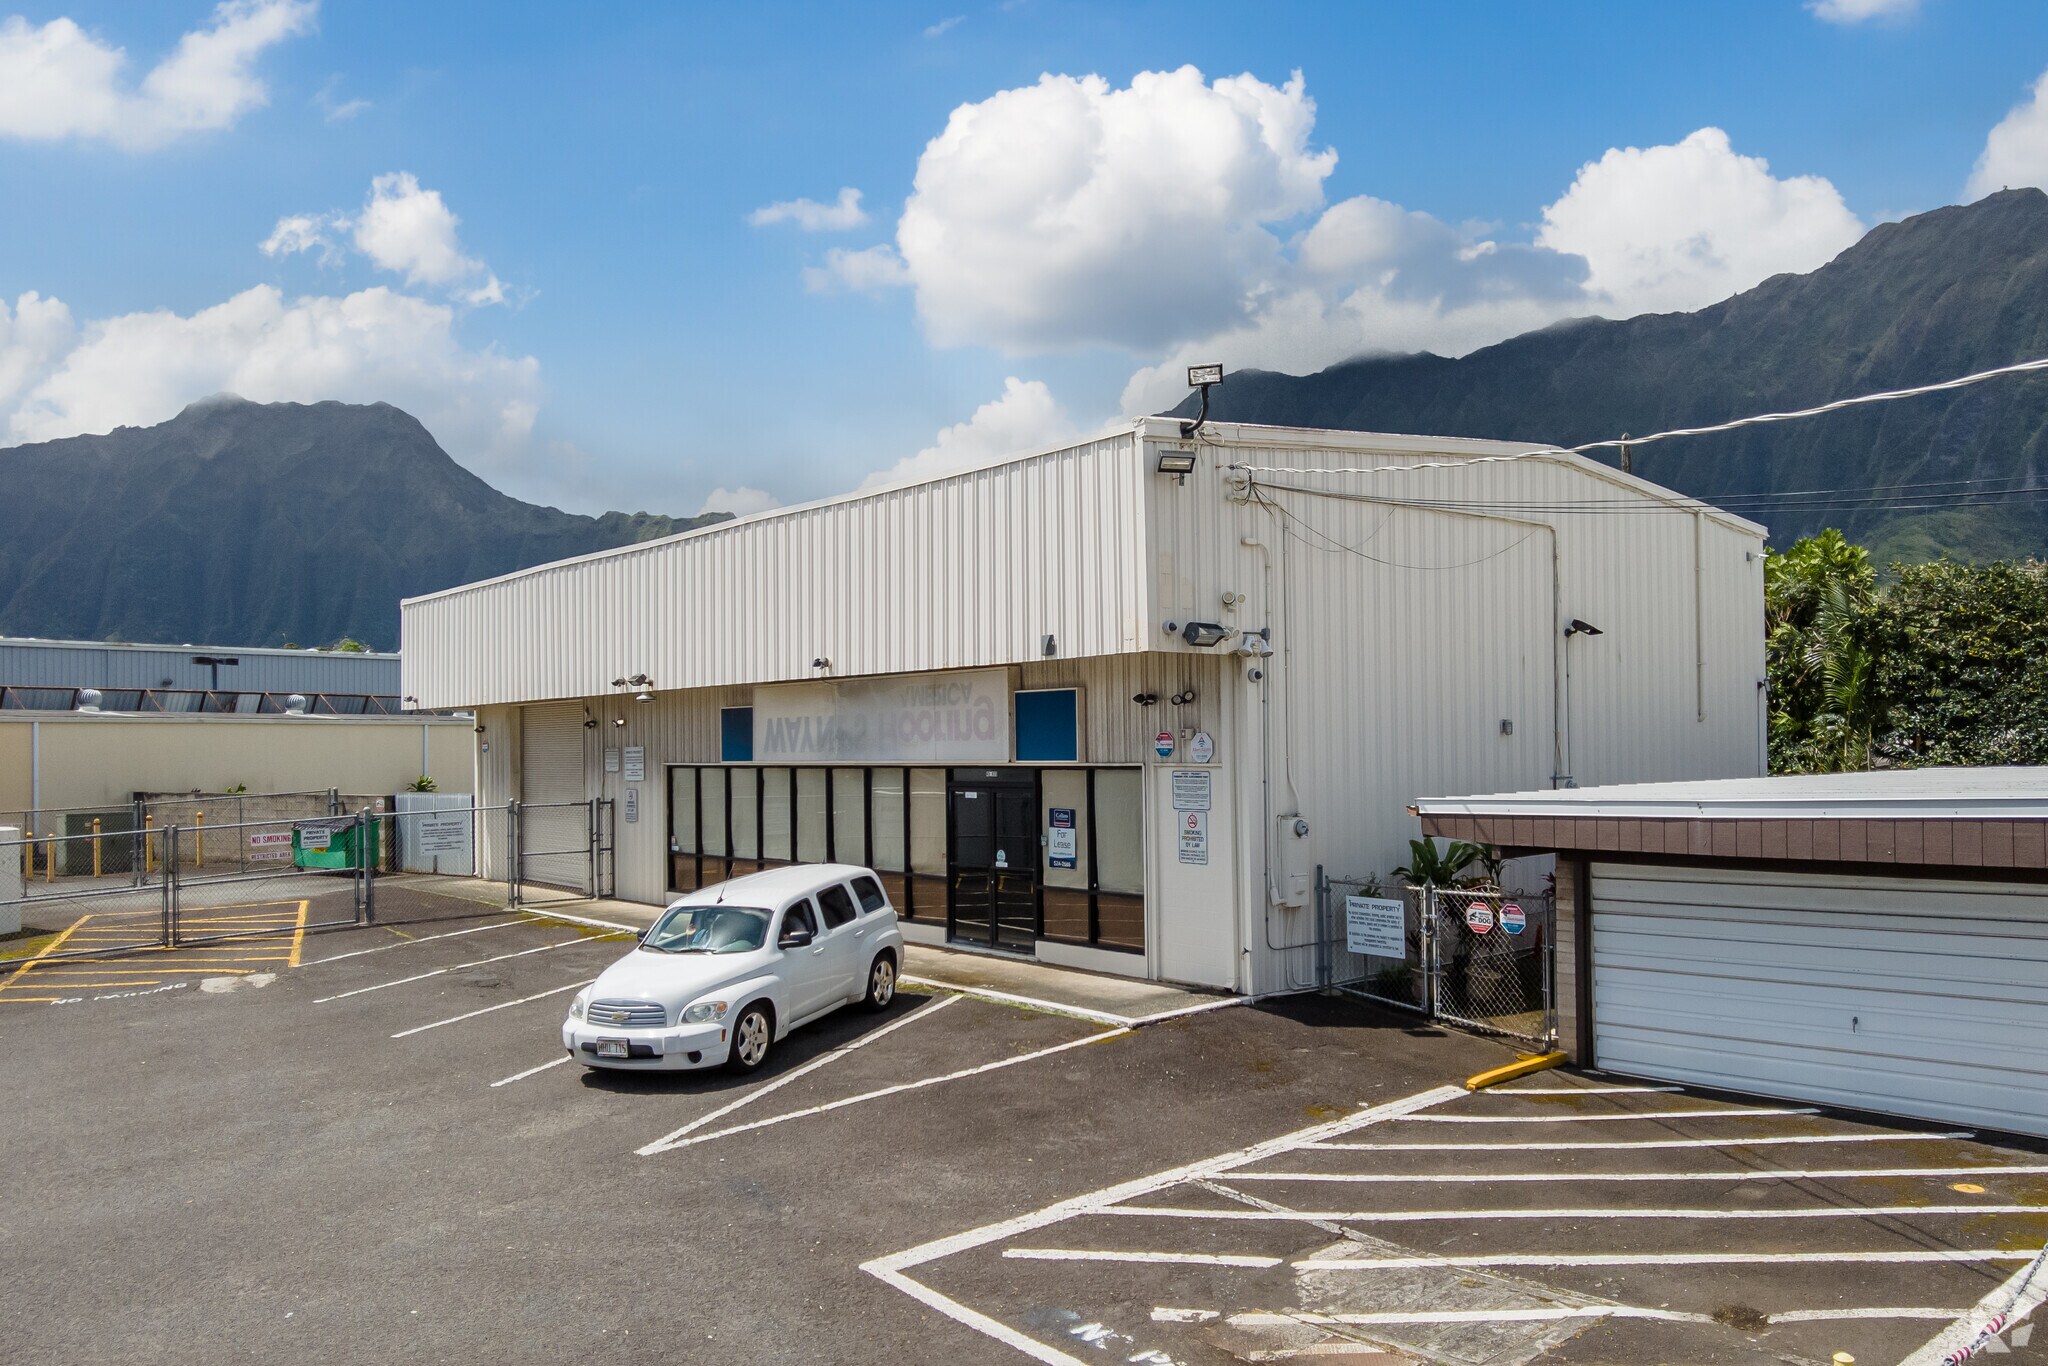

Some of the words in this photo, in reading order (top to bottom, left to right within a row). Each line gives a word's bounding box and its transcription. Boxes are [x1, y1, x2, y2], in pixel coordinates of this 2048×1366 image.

[251, 836, 261, 844] NO
[263, 834, 292, 844] SMOKING
[1057, 829, 1068, 839] For
[1053, 839, 1072, 849] Lease
[1349, 901, 1370, 910] PRIVATE
[1371, 904, 1400, 913] PROPERTY
